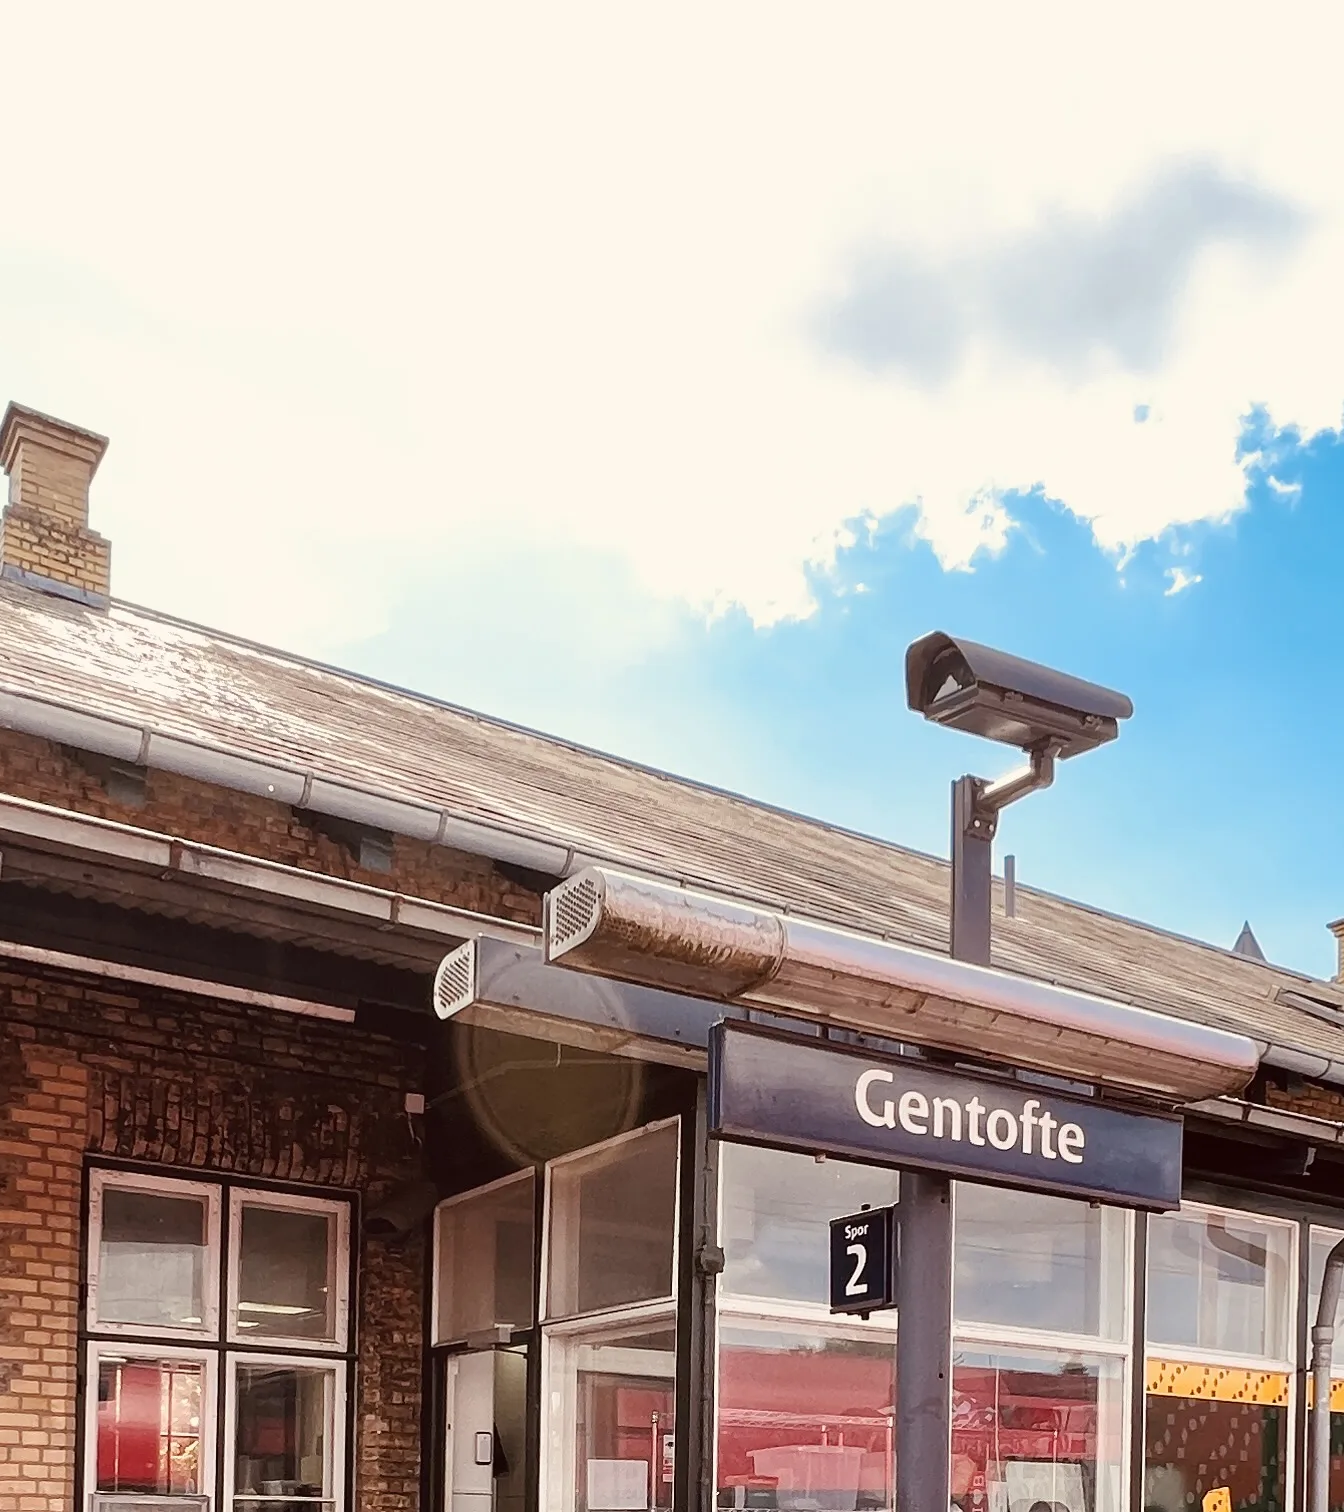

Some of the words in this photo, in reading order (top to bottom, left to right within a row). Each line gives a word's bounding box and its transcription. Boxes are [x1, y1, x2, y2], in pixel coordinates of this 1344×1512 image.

[855, 1068, 1085, 1164] Gentofte
[844, 1224, 870, 1241] Spor
[845, 1243, 868, 1296] 2
